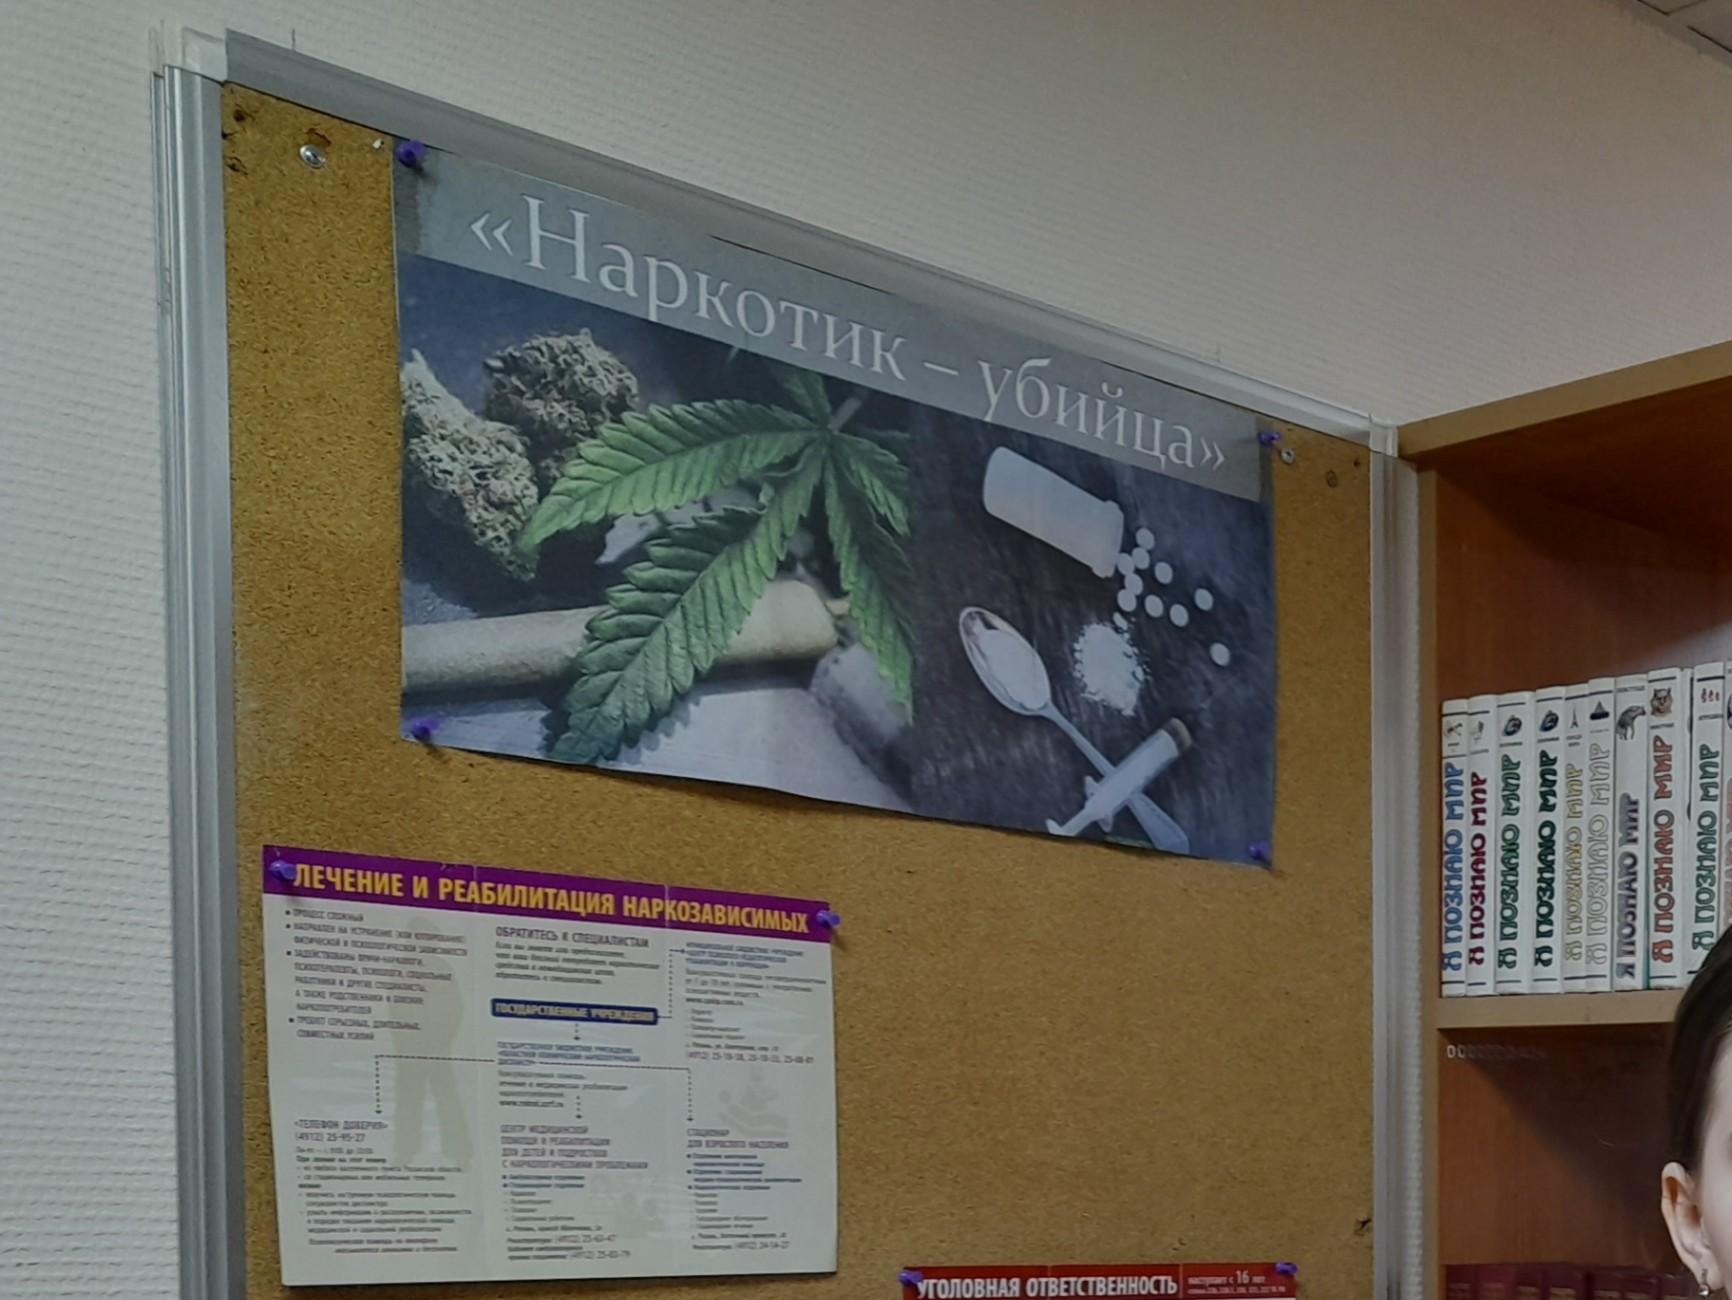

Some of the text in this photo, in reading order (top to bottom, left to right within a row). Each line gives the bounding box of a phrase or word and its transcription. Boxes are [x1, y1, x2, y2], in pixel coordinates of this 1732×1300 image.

[470, 195, 908, 382] «Наркотик
[979, 356, 1227, 471] убийца»
[1502, 754, 1521, 816] МИР
[1538, 750, 1558, 813] МИР
[1654, 735, 1674, 800] МИР
[1699, 743, 1719, 802] МИР
[1564, 763, 1584, 961] Я ПОЗНАЮ МИР
[1586, 743, 1611, 965] Я ПОЗНАЮ МИР
[1620, 792, 1639, 847] МИР
[294, 863, 811, 934] ЛЕЧЕНИЕ И РЕАБИЛИТАЦИЯ НАРКОЗАВИСИМЫХ
[1443, 762, 1464, 970] Я ПОЗНАЮ МИР
[1469, 772, 1487, 965] Я ПОЗНАЮ МИР
[1500, 824, 1520, 941] ПОЗНАЮ
[1536, 820, 1556, 938] ПОЗНАЮ
[1616, 851, 1638, 958] ПОЗНАЮ
[1653, 809, 1674, 934] ПОЗНАЮ
[1695, 810, 1717, 924] ПОЗНАЮ
[1498, 947, 1517, 968] Я
[1534, 945, 1554, 967] Я
[1653, 940, 1674, 963] Я
[916, 1277, 1020, 1300] УГОЛОВНАЯ
[1027, 1275, 1178, 1298] ОТВЕТСТВЕННОСТЬ
